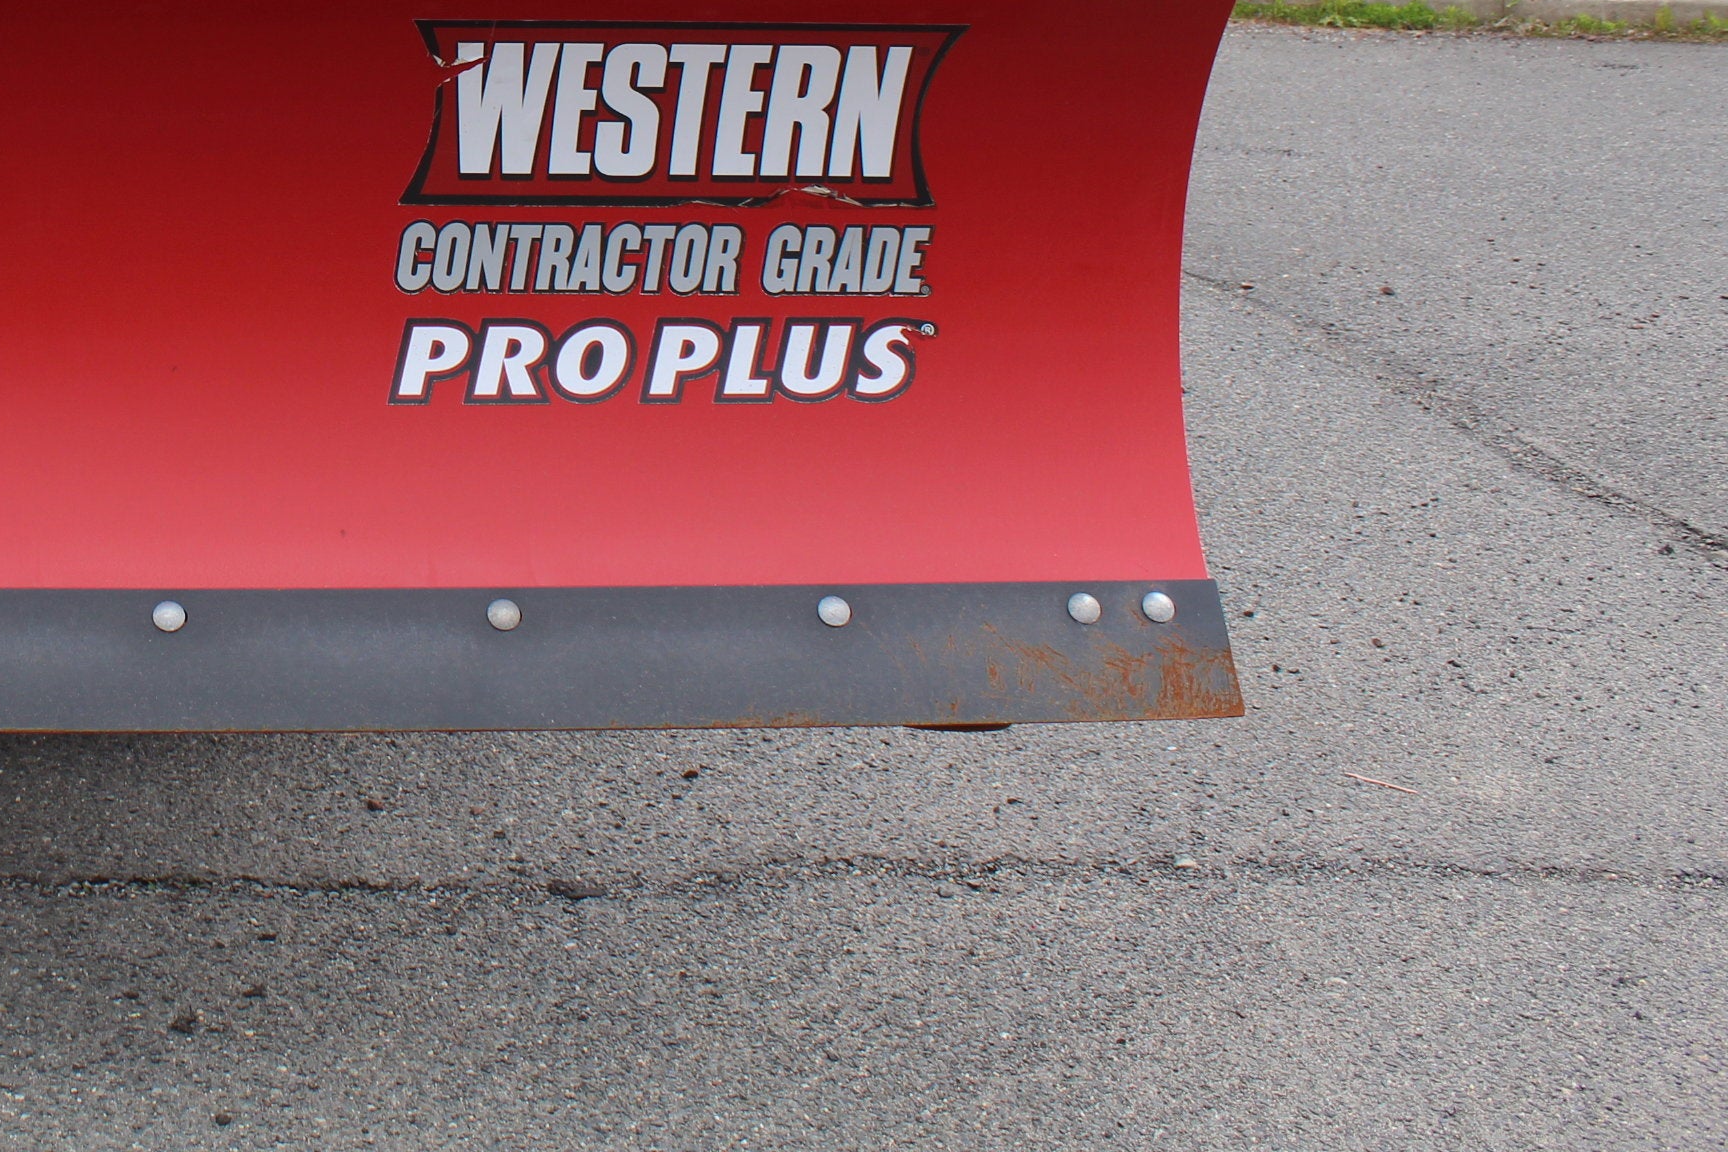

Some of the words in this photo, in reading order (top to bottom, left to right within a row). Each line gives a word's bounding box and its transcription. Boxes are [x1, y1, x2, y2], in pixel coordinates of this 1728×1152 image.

[456, 41, 914, 179] WESTERN
[396, 221, 742, 293] CONTRACTOR
[763, 224, 932, 294] GRADE
[394, 323, 630, 397] PRO
